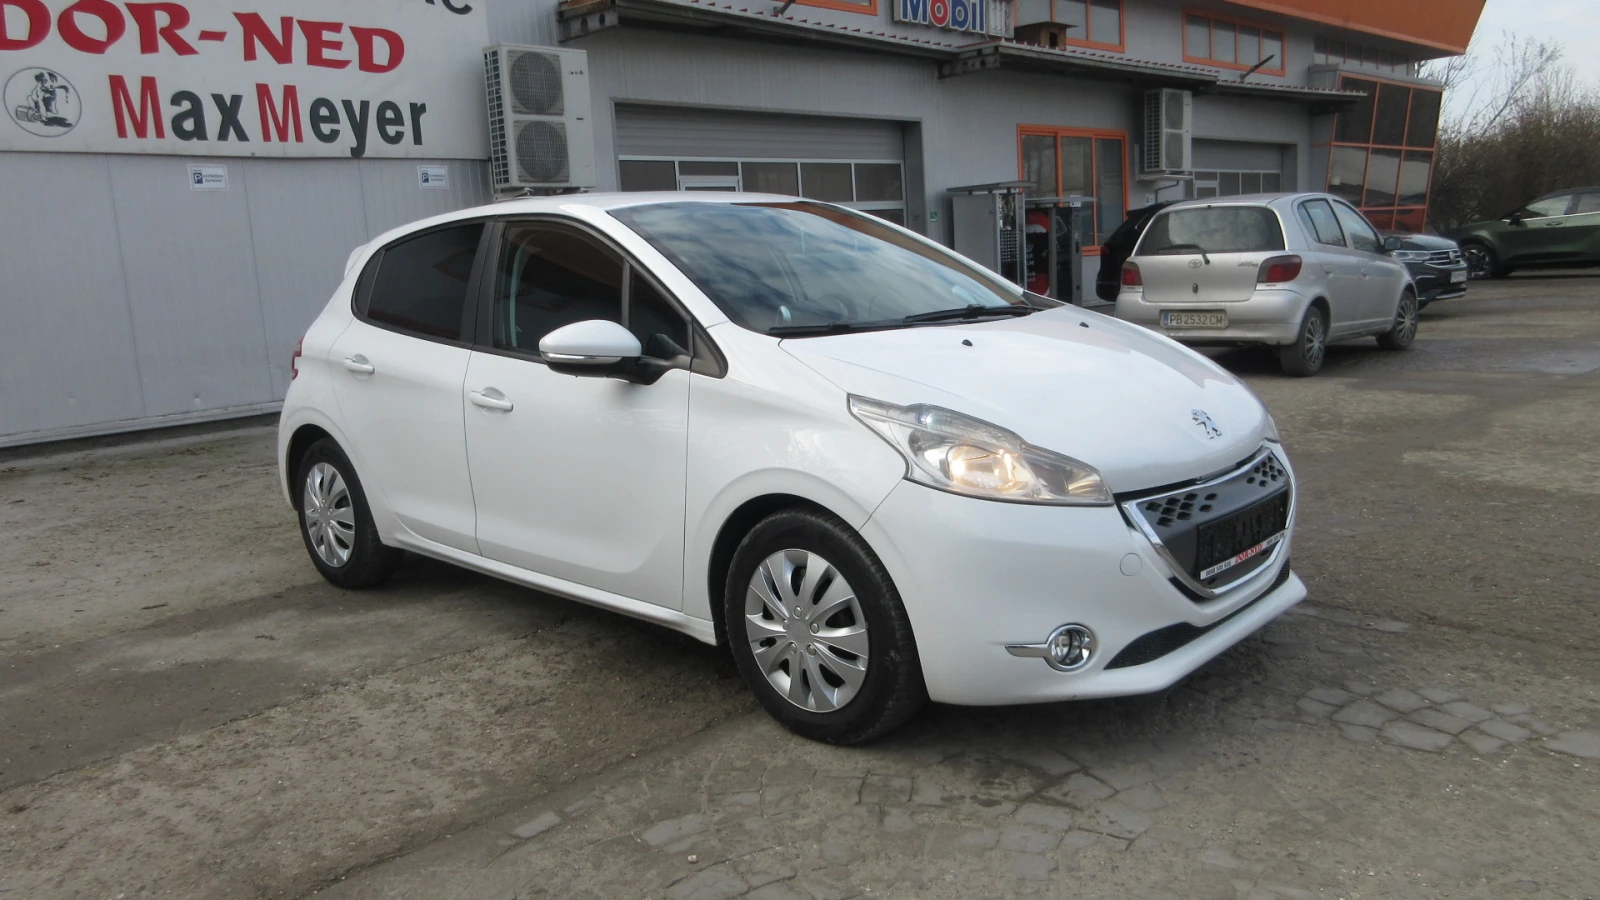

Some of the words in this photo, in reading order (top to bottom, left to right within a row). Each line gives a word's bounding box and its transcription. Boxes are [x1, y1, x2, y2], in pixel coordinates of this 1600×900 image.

[0, 0, 405, 74] DOR-NED
[901, 0, 986, 33] Mobil
[108, 74, 427, 158] MaxMeyer
[1169, 314, 1182, 325] PB
[1184, 314, 1208, 325] 2532
[1209, 314, 1223, 326] CM
